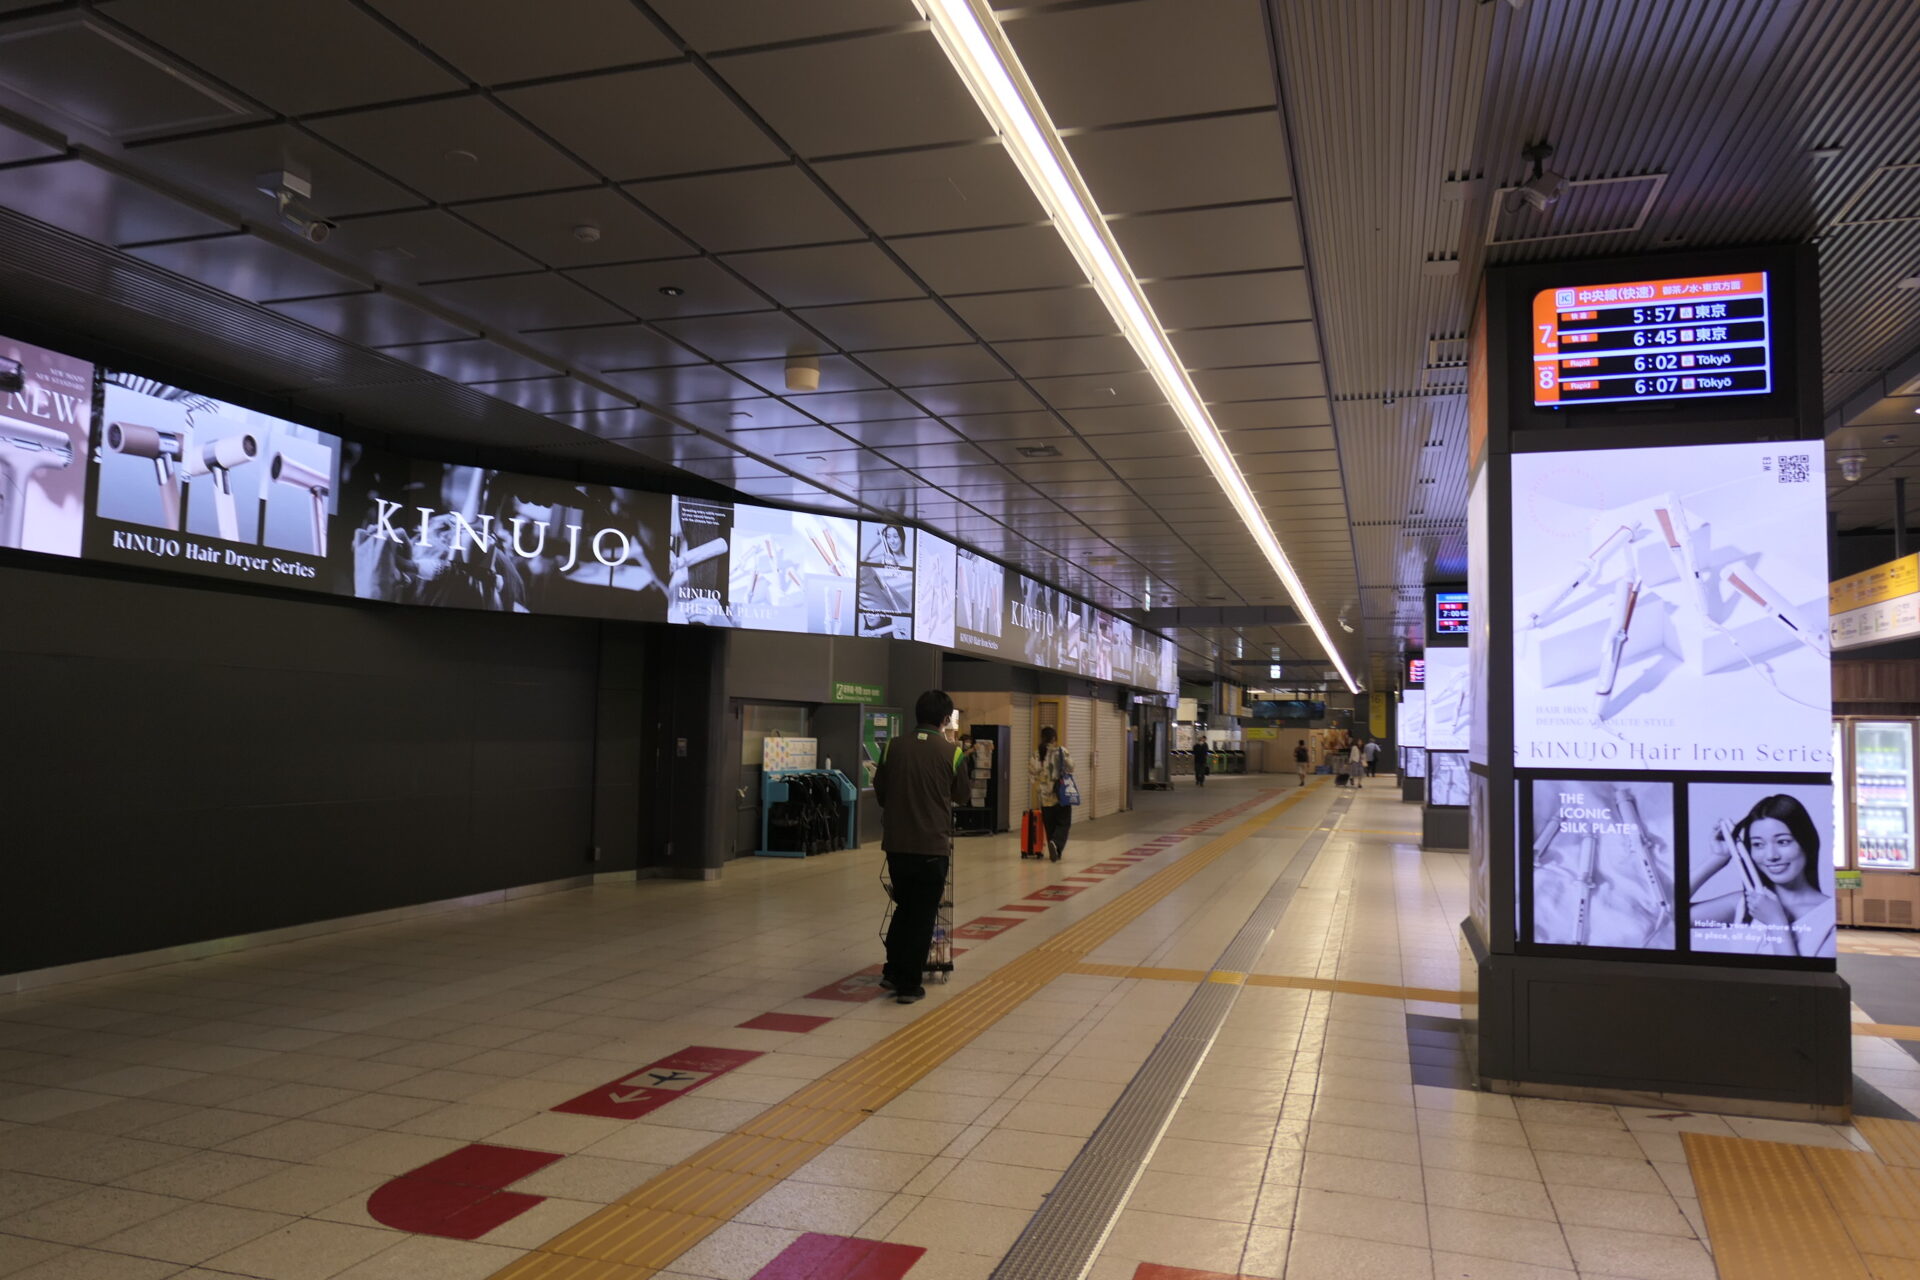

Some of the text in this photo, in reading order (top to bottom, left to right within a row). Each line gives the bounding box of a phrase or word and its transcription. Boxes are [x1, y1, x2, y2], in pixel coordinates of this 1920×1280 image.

[1579, 286, 1655, 303] 中央線(快速)
[1633, 306, 1676, 323] 5:57
[1695, 303, 1727, 319] 東京
[1538, 325, 1553, 344] 7
[1633, 329, 1677, 346] 6:45
[1695, 326, 1728, 342] 東京
[1634, 354, 1678, 371] 6:02
[1539, 370, 1555, 389] 8
[1634, 377, 1678, 394] 6:07
[6, 383, 83, 425] NEW
[1762, 456, 1772, 472] WEB
[374, 498, 630, 572] KINUJO
[113, 530, 315, 578] KINUJO Hair Dryer Series
[1011, 600, 1054, 639] KINUJO
[1645, 719, 1675, 727] STYLE
[1531, 740, 1618, 762] KINUJO
[1630, 742, 1682, 760] Hair
[1694, 743, 1744, 761] Iron
[1560, 793, 1584, 804] THE
[1560, 807, 1611, 819] ICONIC
[1560, 822, 1588, 833] SILK
[1694, 920, 1727, 929] Holding
[1792, 924, 1812, 934] style
